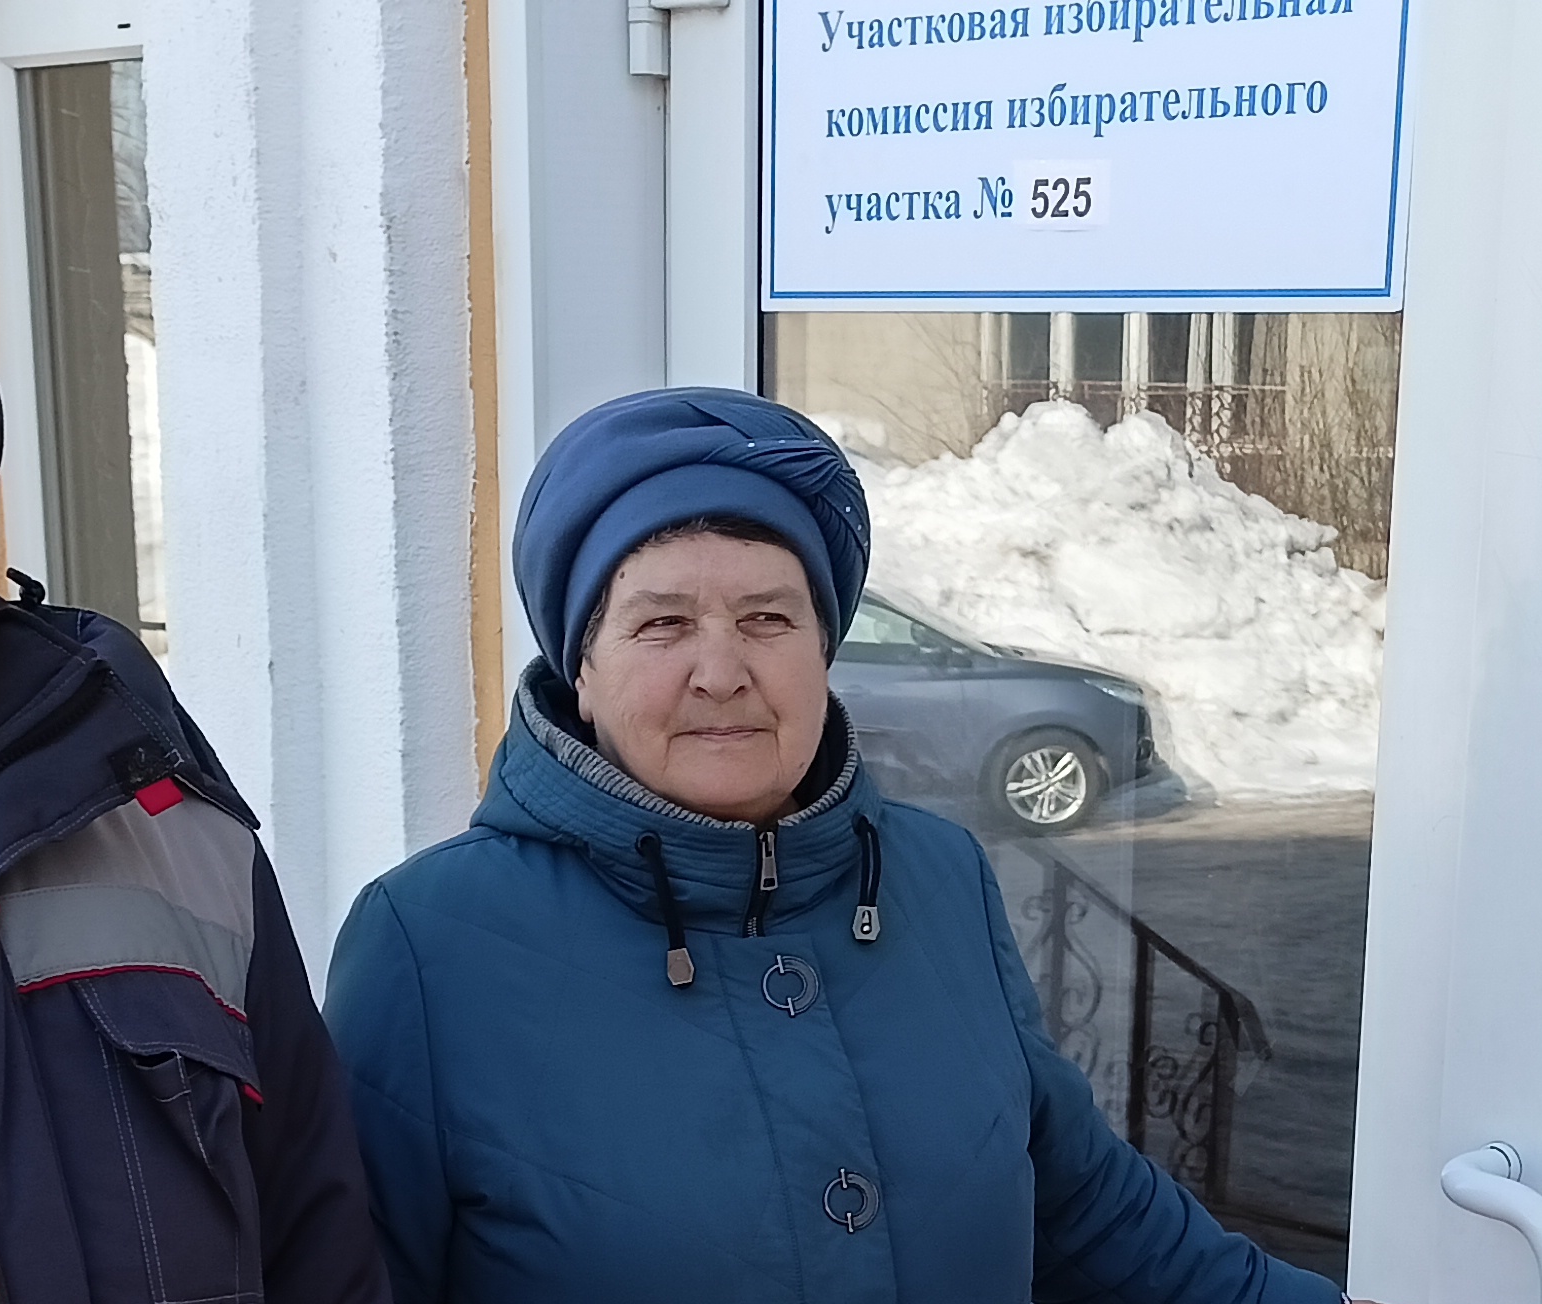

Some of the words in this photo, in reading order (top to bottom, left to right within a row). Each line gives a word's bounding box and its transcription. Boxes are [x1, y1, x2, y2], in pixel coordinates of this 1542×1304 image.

[820, 5, 1030, 53] Участковая
[825, 99, 994, 138] комиссия
[1005, 80, 1329, 138] избирательного
[824, 185, 962, 235] участка
[972, 177, 1013, 219] №
[1029, 177, 1093, 219] 525
